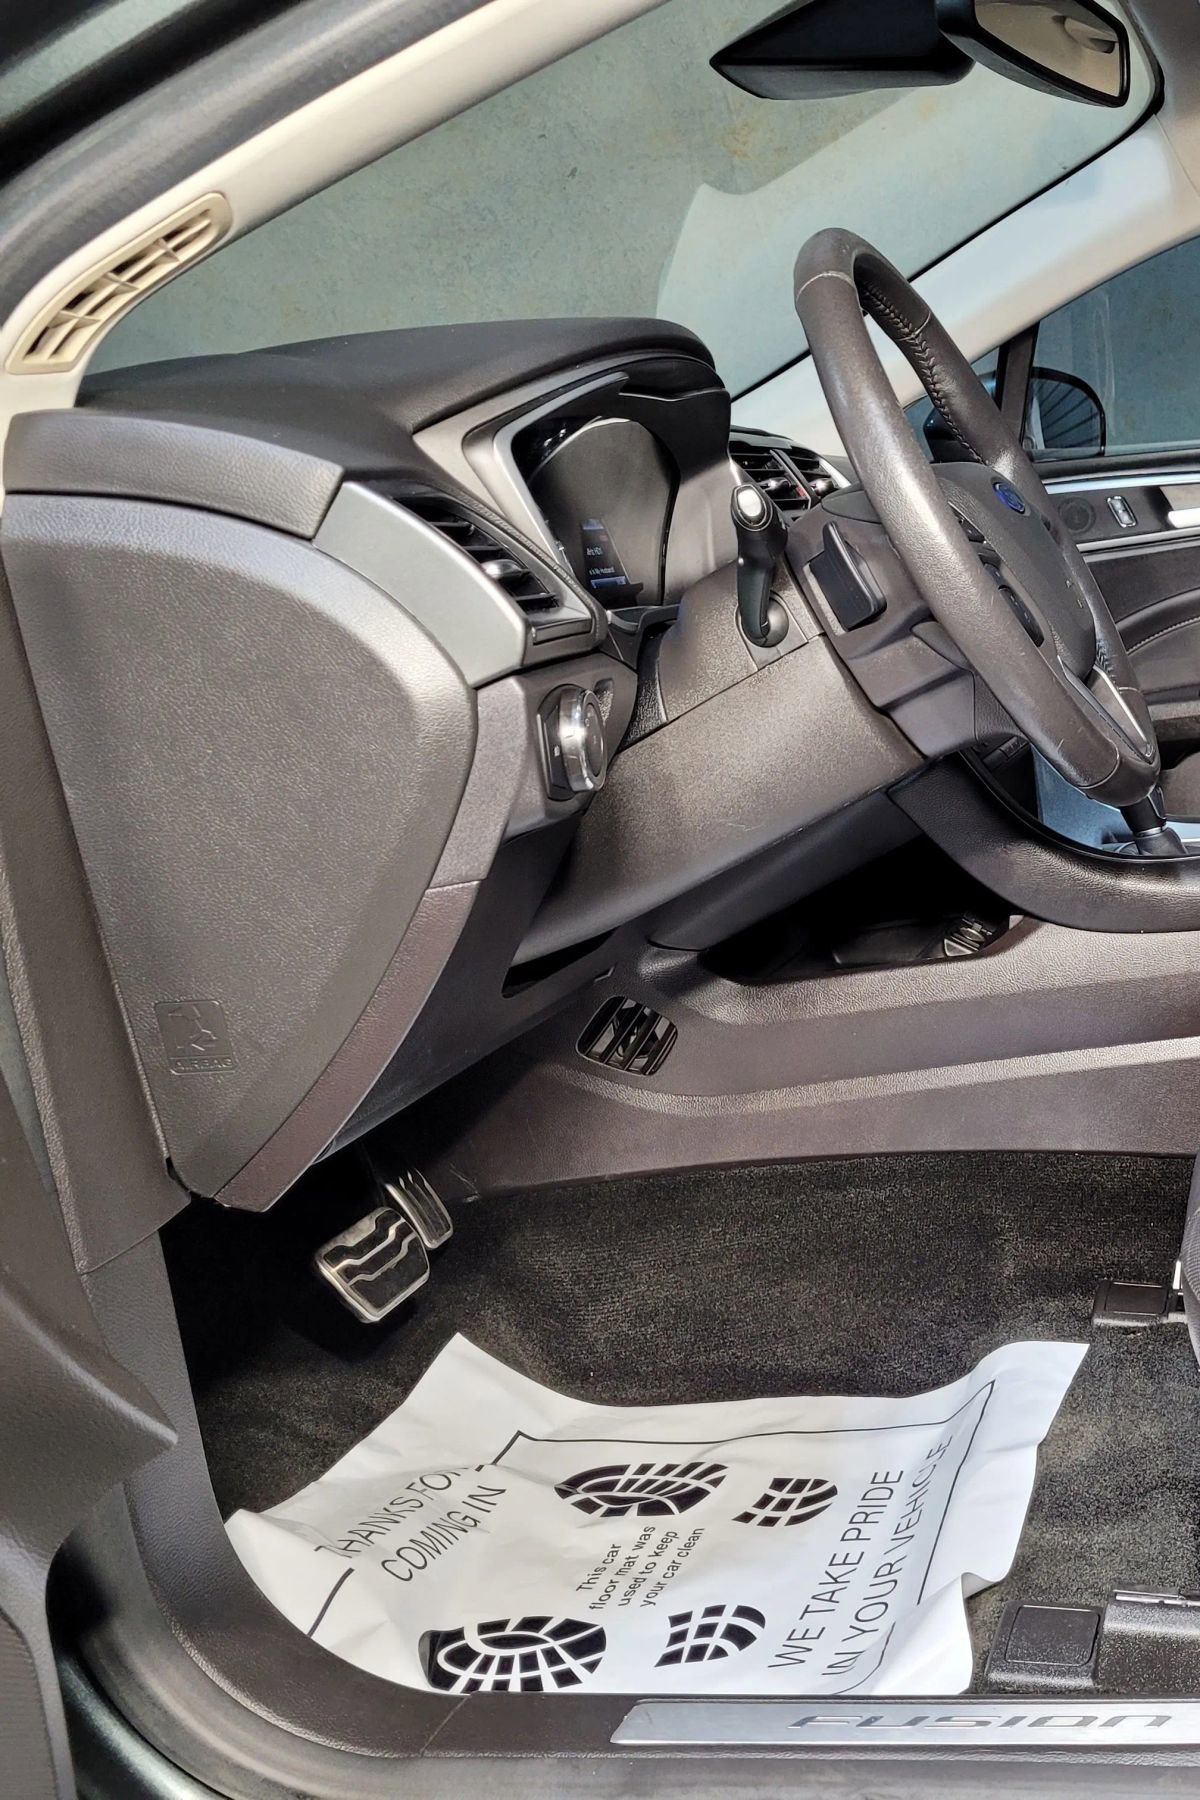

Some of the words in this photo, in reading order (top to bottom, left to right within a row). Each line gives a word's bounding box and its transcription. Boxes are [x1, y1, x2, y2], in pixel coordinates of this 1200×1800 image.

[314, 1496, 424, 1558] THANKS
[405, 1470, 462, 1501] FO
[381, 1510, 482, 1582] COMING
[462, 1485, 507, 1513] IN
[884, 1436, 953, 1555] VEHICLE
[576, 1566, 607, 1591] This
[602, 1543, 622, 1565] car
[588, 1579, 620, 1610] floor
[615, 1554, 639, 1576] mat
[632, 1526, 656, 1551] was
[640, 1581, 668, 1607] your
[662, 1560, 682, 1579] car
[677, 1528, 705, 1558] clean
[640, 1561, 657, 1575] to
[648, 1531, 680, 1557] keep
[767, 1626, 826, 1668] WE
[799, 1551, 864, 1621] TAKE
[840, 1470, 904, 1542] PRIDE
[618, 1577, 648, 1606] used
[841, 1555, 907, 1642] YOUR
[821, 1649, 866, 1676] IN
[787, 1715, 1173, 1729] FUSION
